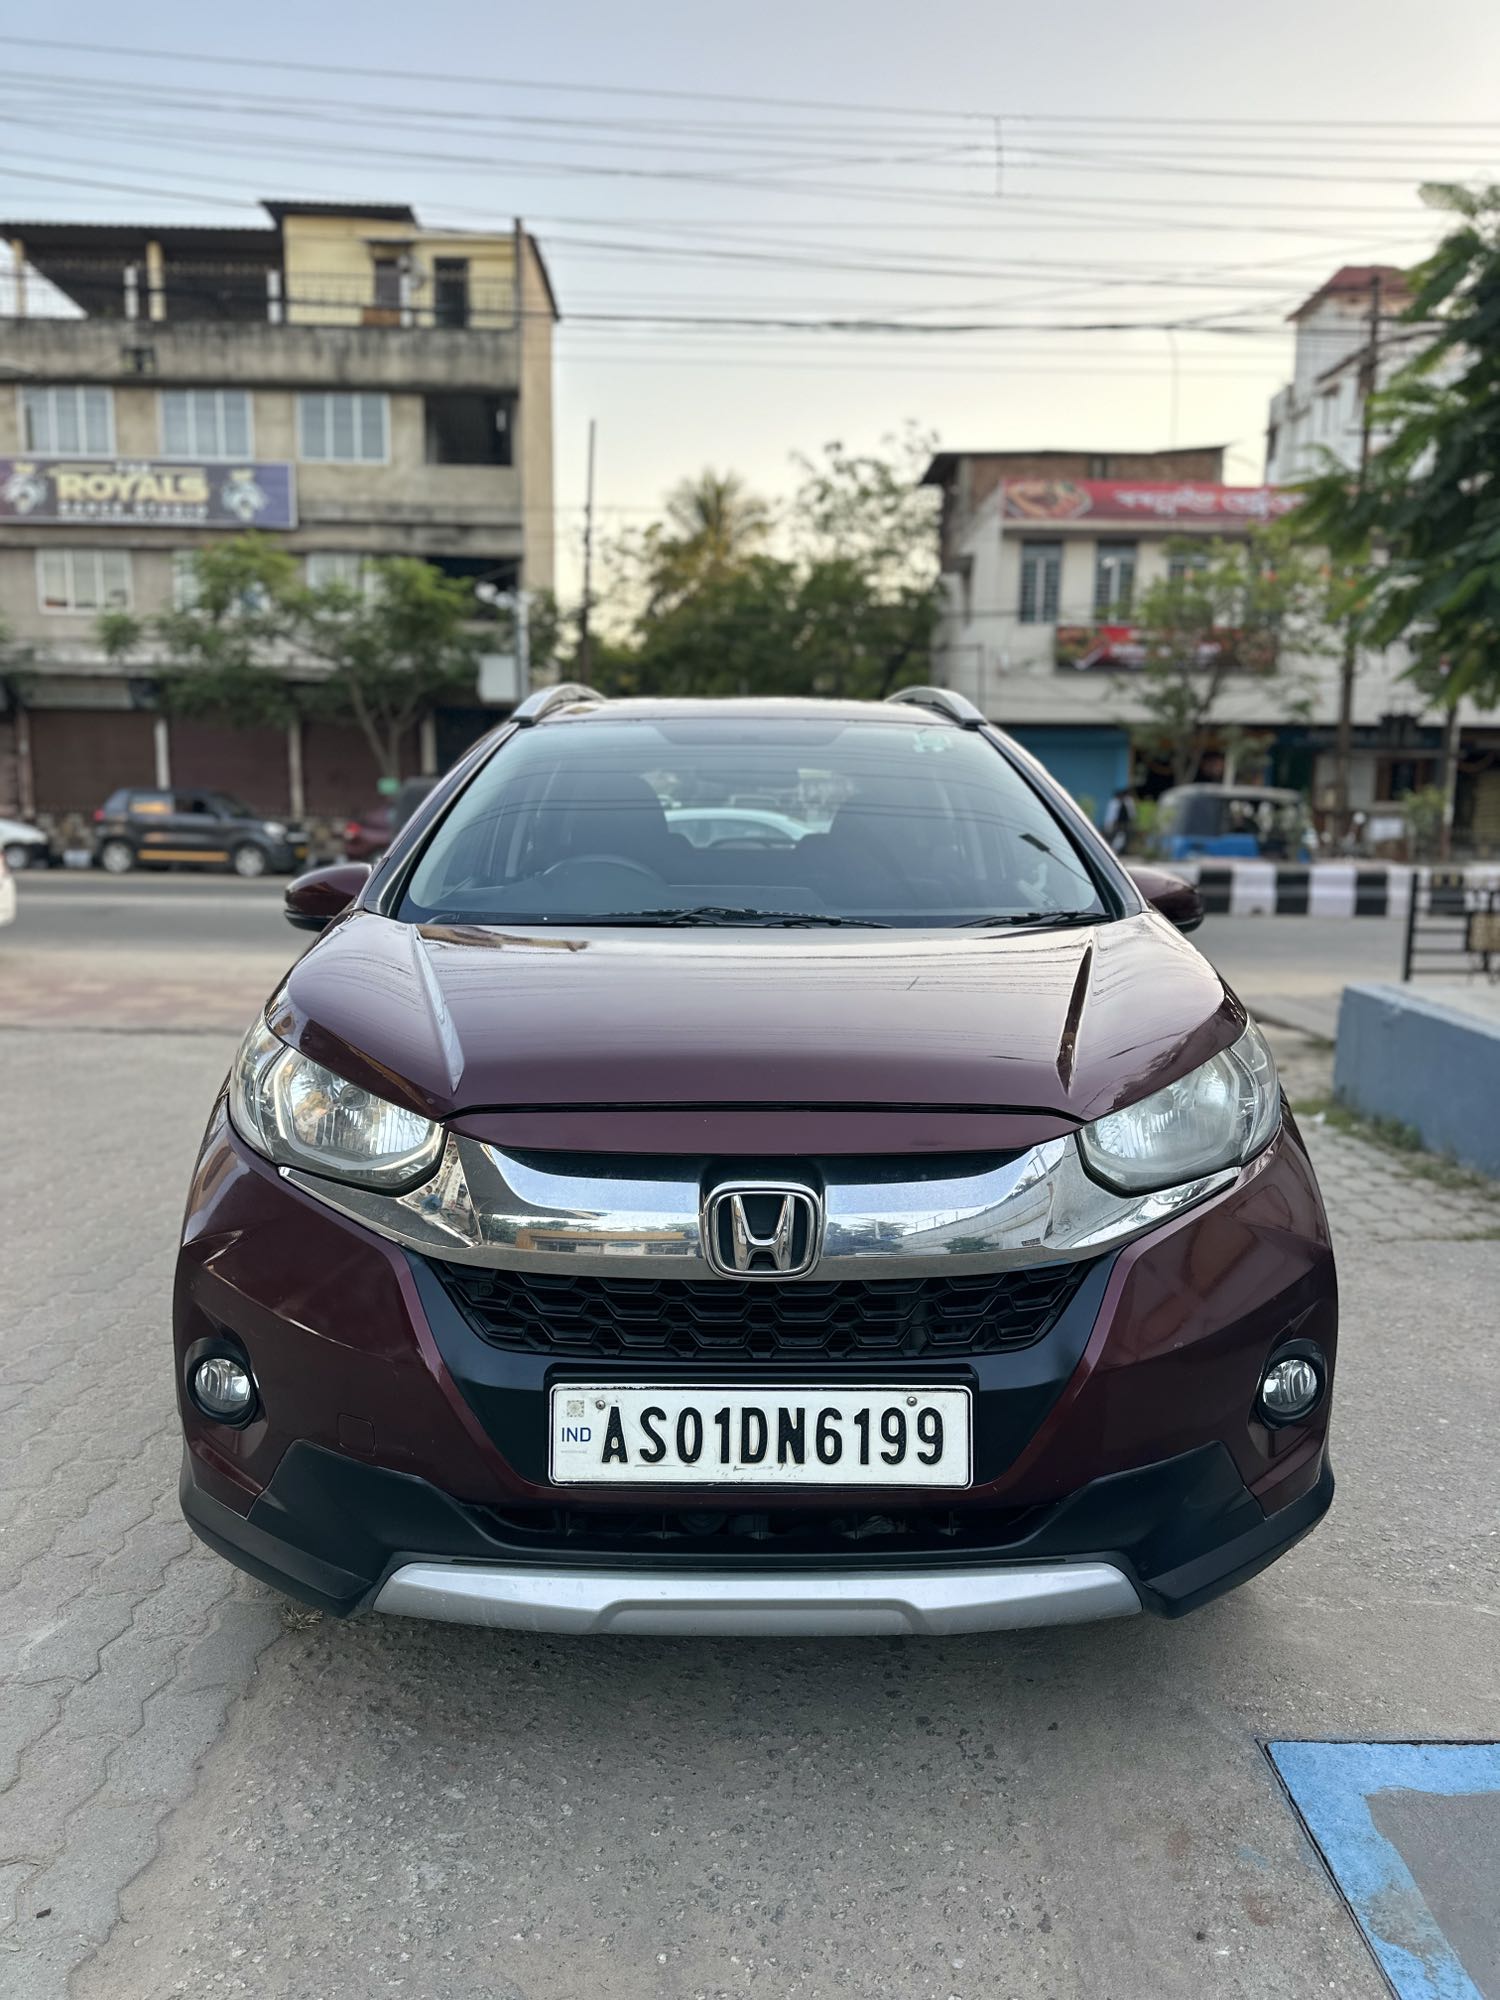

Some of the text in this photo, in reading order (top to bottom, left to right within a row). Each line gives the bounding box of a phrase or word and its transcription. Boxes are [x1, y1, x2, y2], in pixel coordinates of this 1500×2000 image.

[57, 473, 209, 503] ROYALS
[561, 1427, 592, 1443] IND
[601, 1406, 945, 1466] AS01DN6199
